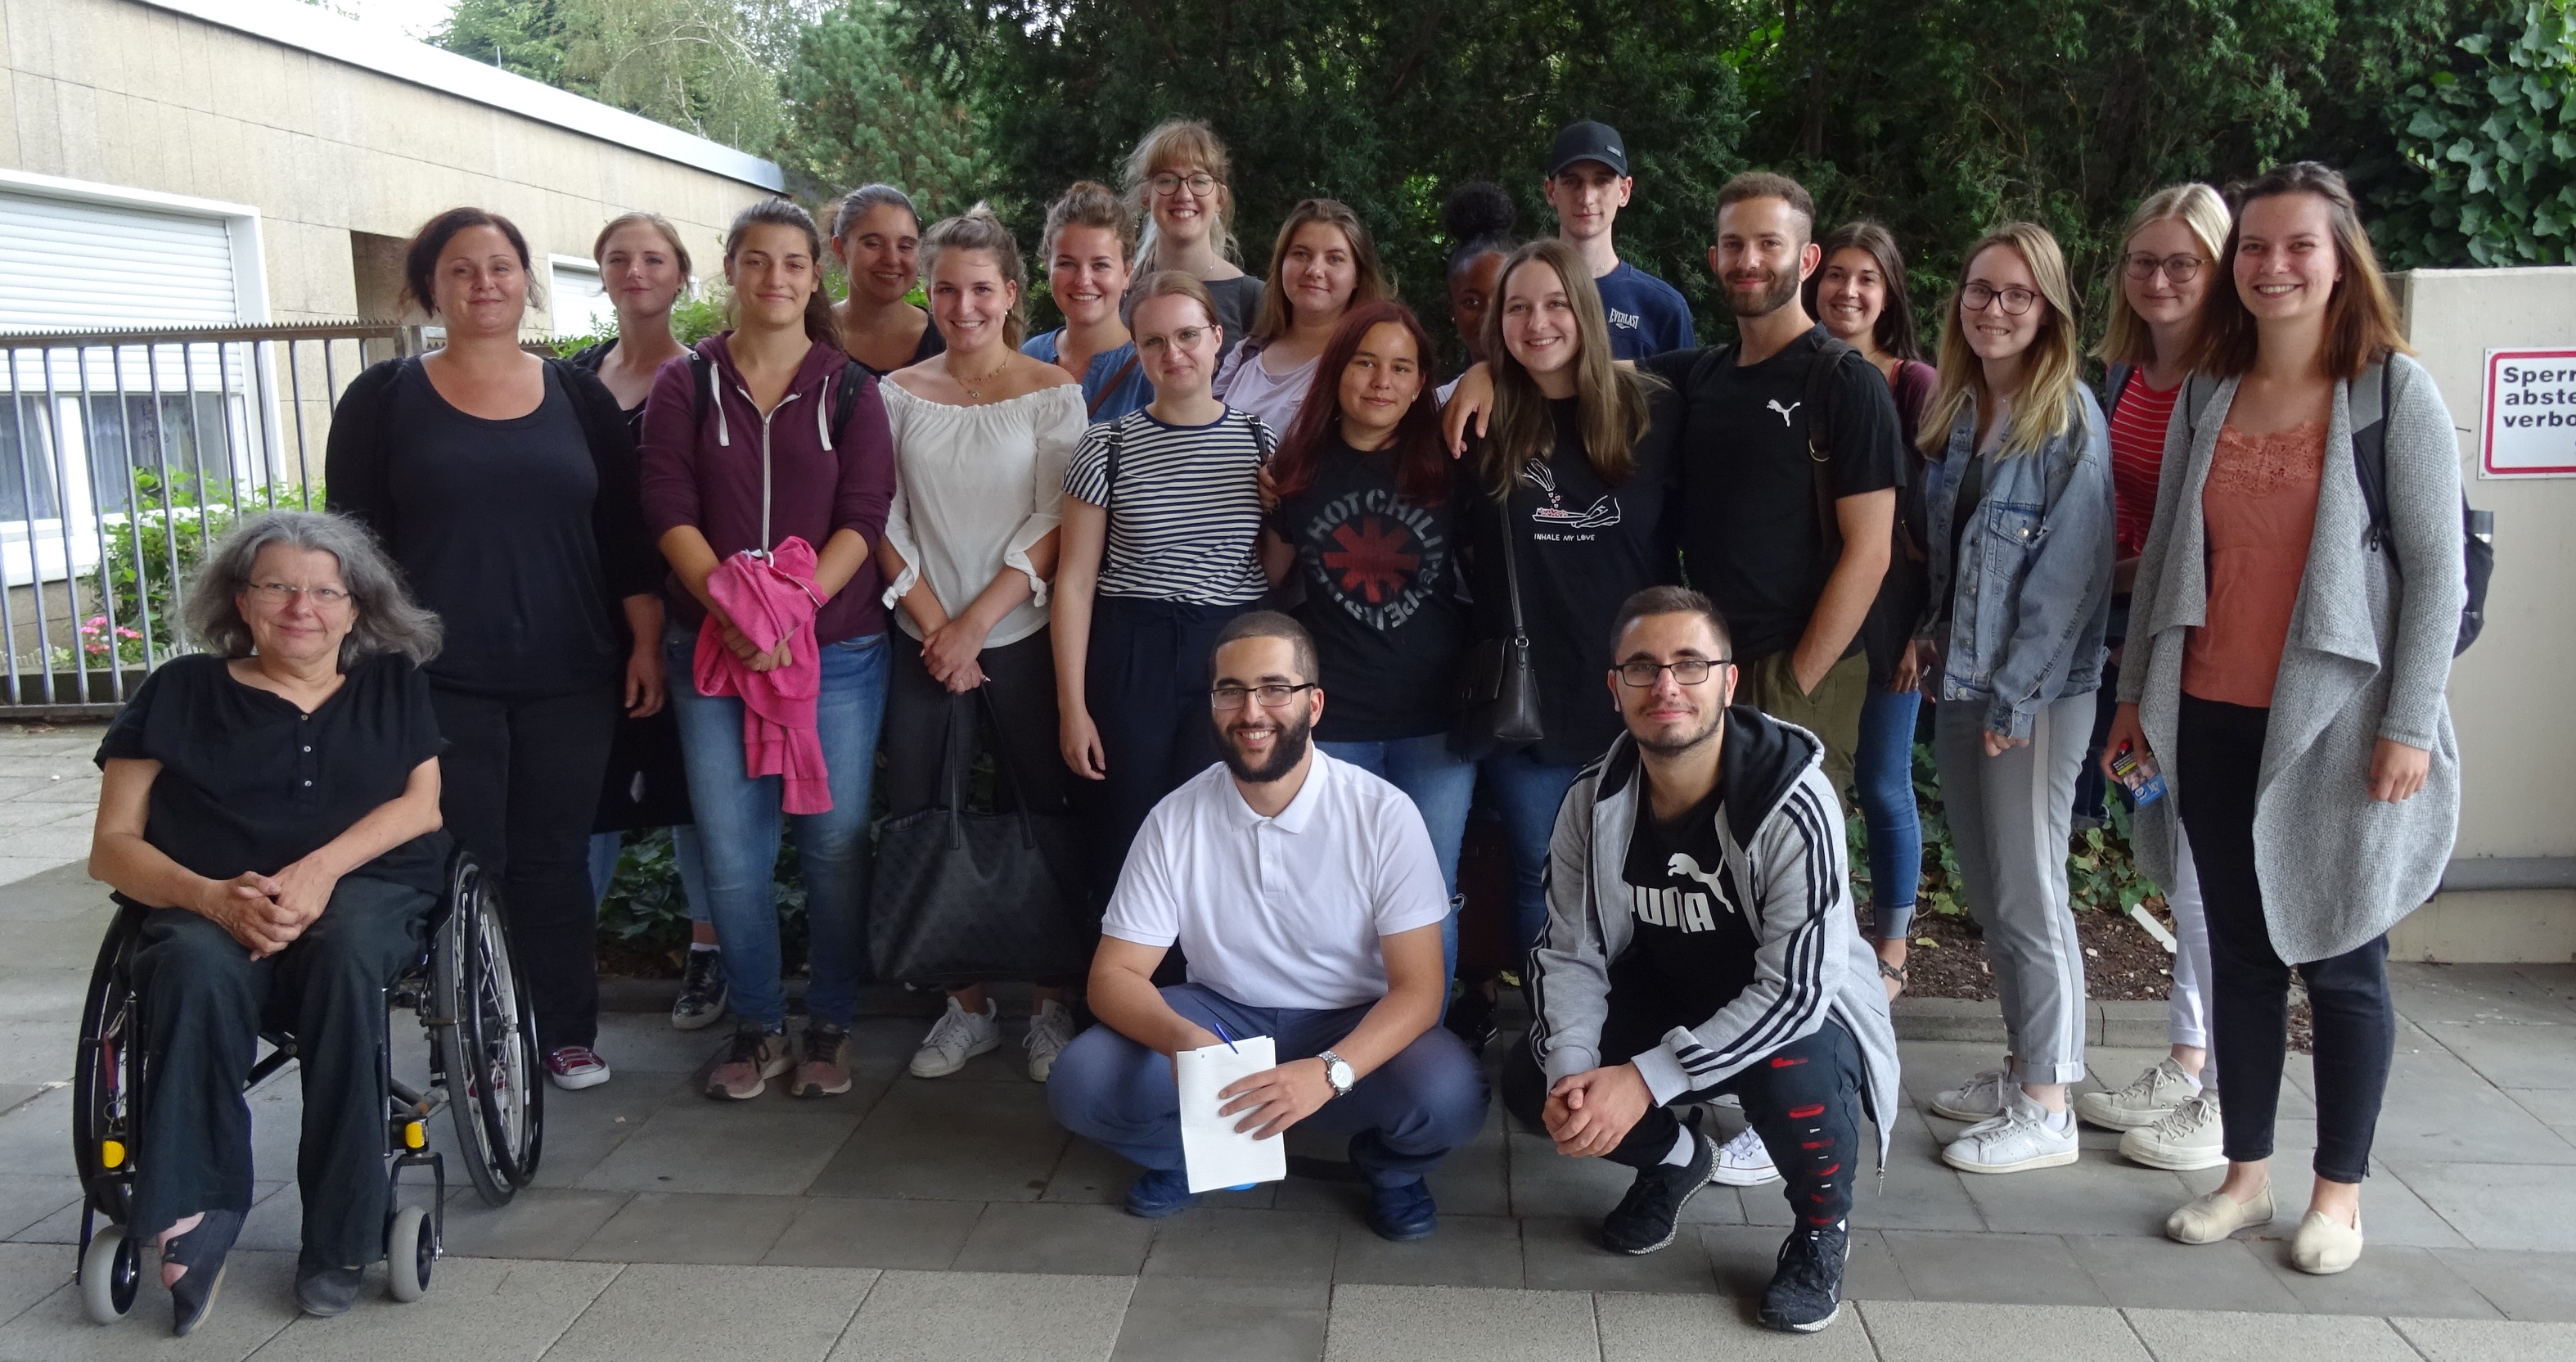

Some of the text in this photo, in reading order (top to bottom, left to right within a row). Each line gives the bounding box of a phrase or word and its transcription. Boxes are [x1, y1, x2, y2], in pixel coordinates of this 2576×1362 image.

[1608, 307, 1640, 330] EVERLAST
[1306, 491, 1360, 543] HOT
[1366, 488, 1444, 549] CHILI
[1533, 533, 1560, 541] INHALE
